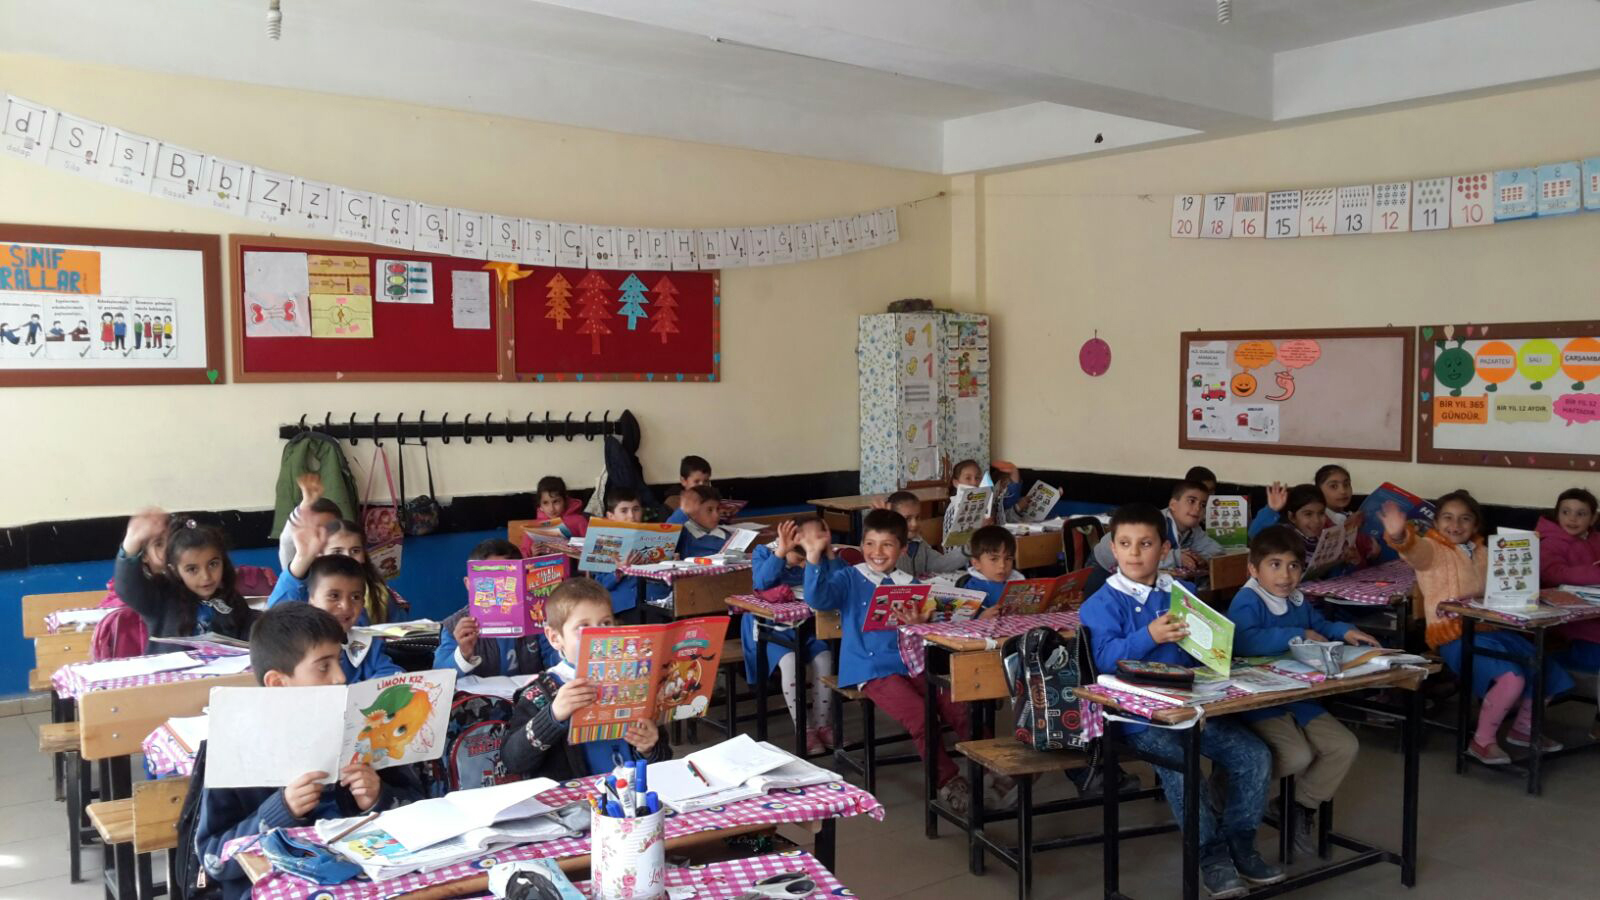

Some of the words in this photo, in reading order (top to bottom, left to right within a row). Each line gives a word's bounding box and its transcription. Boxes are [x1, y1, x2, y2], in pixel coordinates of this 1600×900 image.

[15, 111, 32, 133] d
[68, 127, 84, 148] S
[123, 148, 135, 161] s
[170, 153, 186, 178] B
[1554, 167, 1561, 178] 8
[219, 166, 233, 190] b
[1511, 172, 1519, 183] 9
[262, 179, 281, 202] Z
[309, 193, 321, 206] z
[1181, 196, 1194, 211] 19
[1213, 196, 1226, 211] 17
[1381, 211, 1400, 230] 12
[1423, 208, 1438, 227] 11
[1462, 204, 1484, 223] 10
[426, 213, 440, 232] G
[465, 221, 475, 238] g
[1176, 219, 1193, 234] 20
[1210, 220, 1224, 235] 18
[1240, 218, 1256, 235] 16
[1275, 218, 1292, 235] 15
[1307, 216, 1327, 233] 14
[1345, 213, 1363, 232] 13
[563, 230, 577, 248] C
[596, 235, 604, 248] c
[627, 234, 636, 251] P
[654, 238, 662, 252] p
[679, 236, 690, 251] H
[707, 237, 714, 249] h
[730, 236, 740, 251] V
[9, 244, 65, 269] SINIF
[923, 352, 934, 379] 1
[1439, 400, 1453, 408] BİR
[922, 419, 933, 445] 1
[506, 648, 518, 670] 2
[376, 675, 407, 690] LİMON
[409, 675, 424, 684] KIZ
